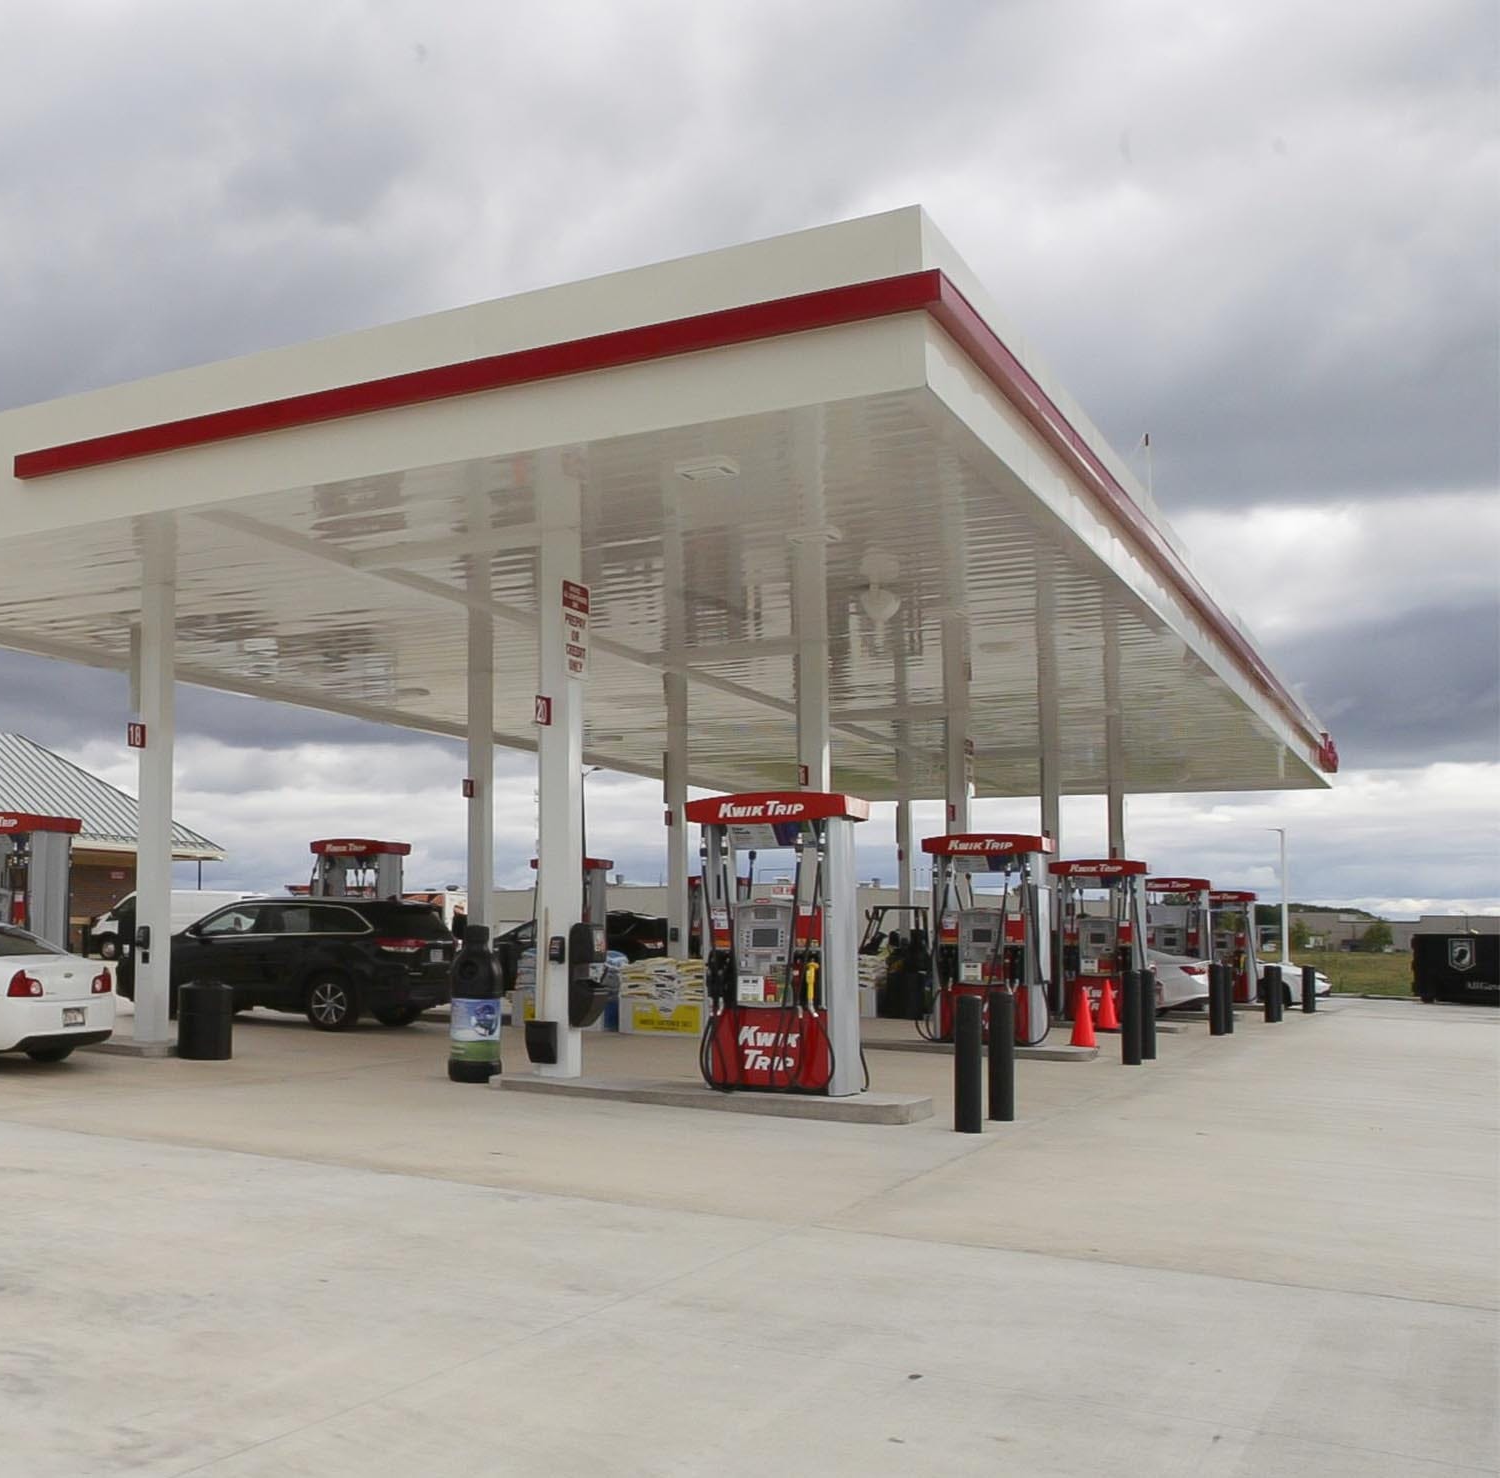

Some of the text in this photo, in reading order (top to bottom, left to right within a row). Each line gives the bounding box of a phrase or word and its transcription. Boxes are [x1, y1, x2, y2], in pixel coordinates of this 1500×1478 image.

[130, 724, 141, 746] 18
[718, 801, 804, 818] KWIK TRIP
[948, 839, 1013, 850] KWIK TRIP
[738, 1026, 799, 1047] KWIK
